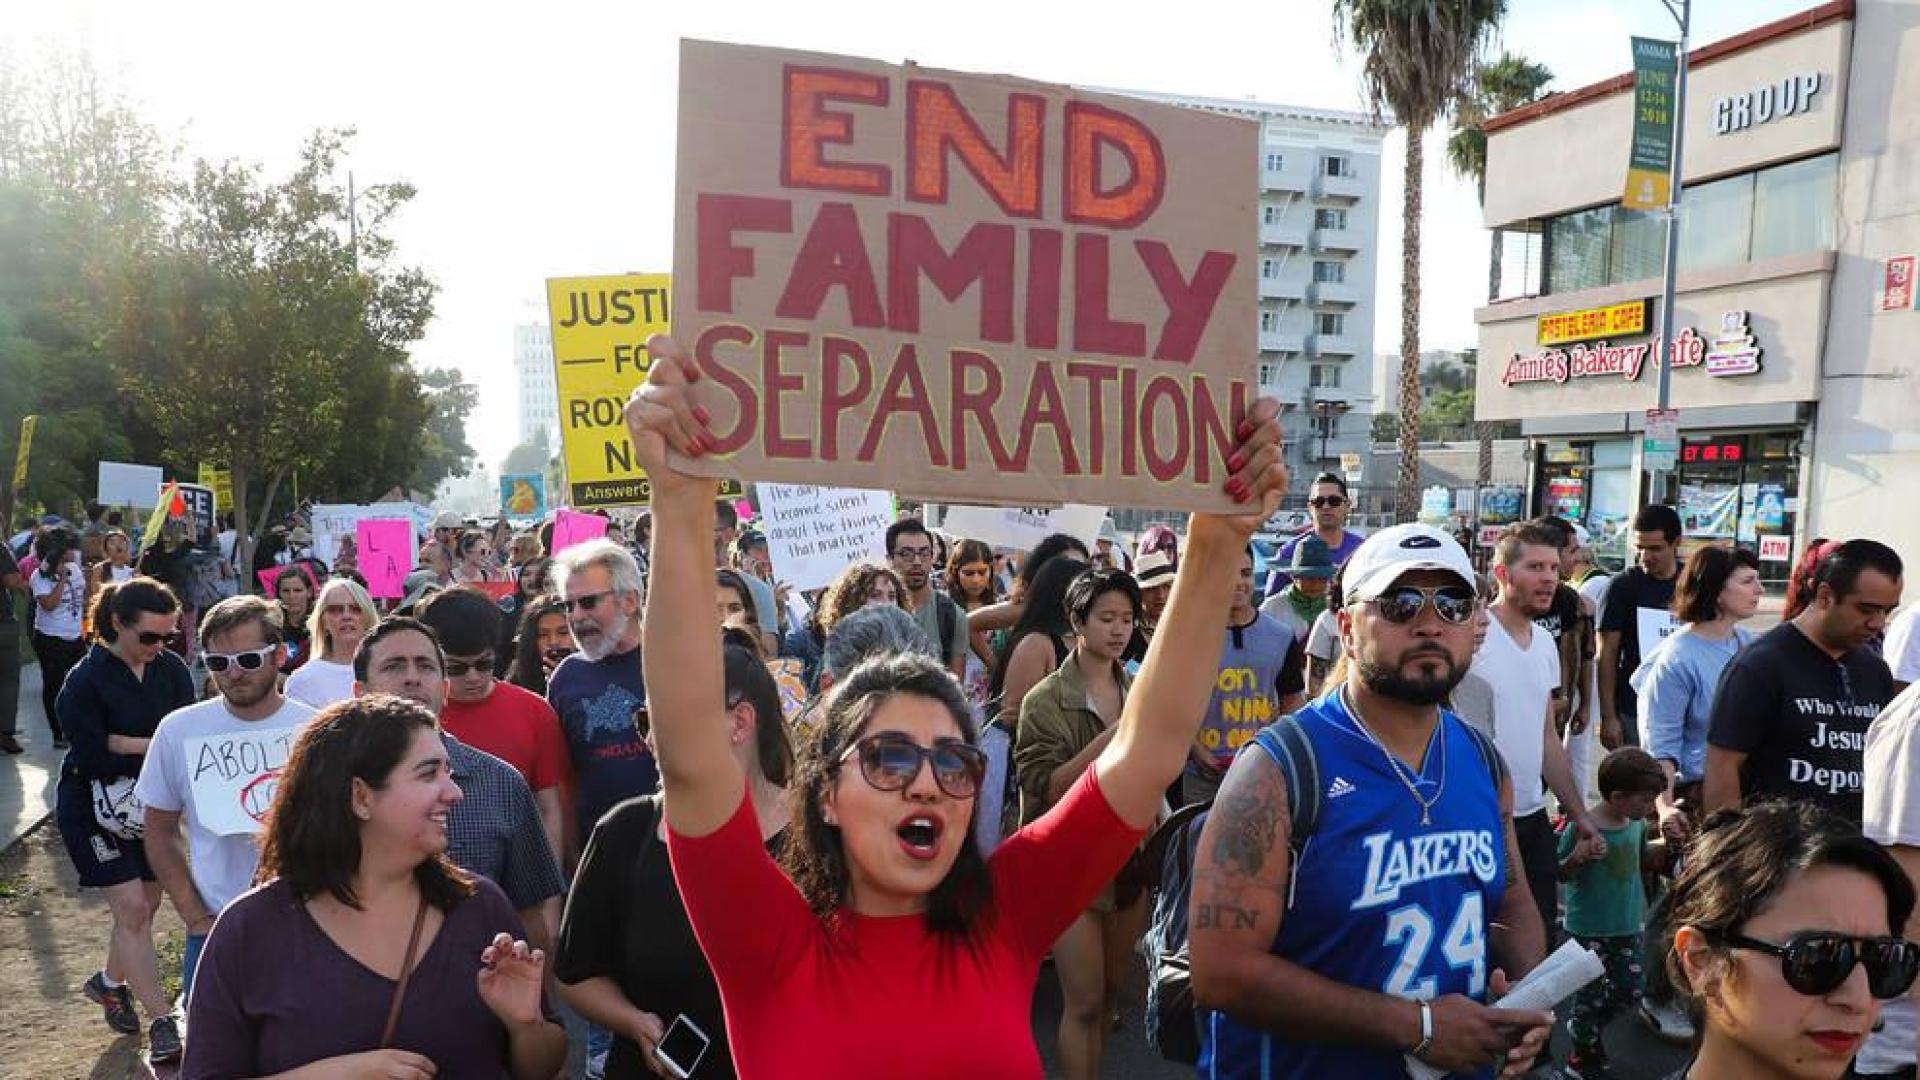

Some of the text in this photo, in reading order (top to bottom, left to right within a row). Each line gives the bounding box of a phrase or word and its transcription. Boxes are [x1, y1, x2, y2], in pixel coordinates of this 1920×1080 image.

[1711, 69, 1822, 136] GROUP
[780, 63, 1167, 230] END
[559, 288, 669, 328] JUSTI
[696, 191, 1238, 365] FAMILY
[1502, 351, 1568, 386] Annie's
[1571, 341, 1648, 382] Bakery
[692, 323, 1248, 487] SEPARATION
[1761, 541, 1788, 556] ATM
[1795, 697, 1835, 716] Who
[1809, 721, 1864, 751] Jesu
[1349, 829, 1498, 910] LAKERS
[1382, 889, 1488, 1001] 24
